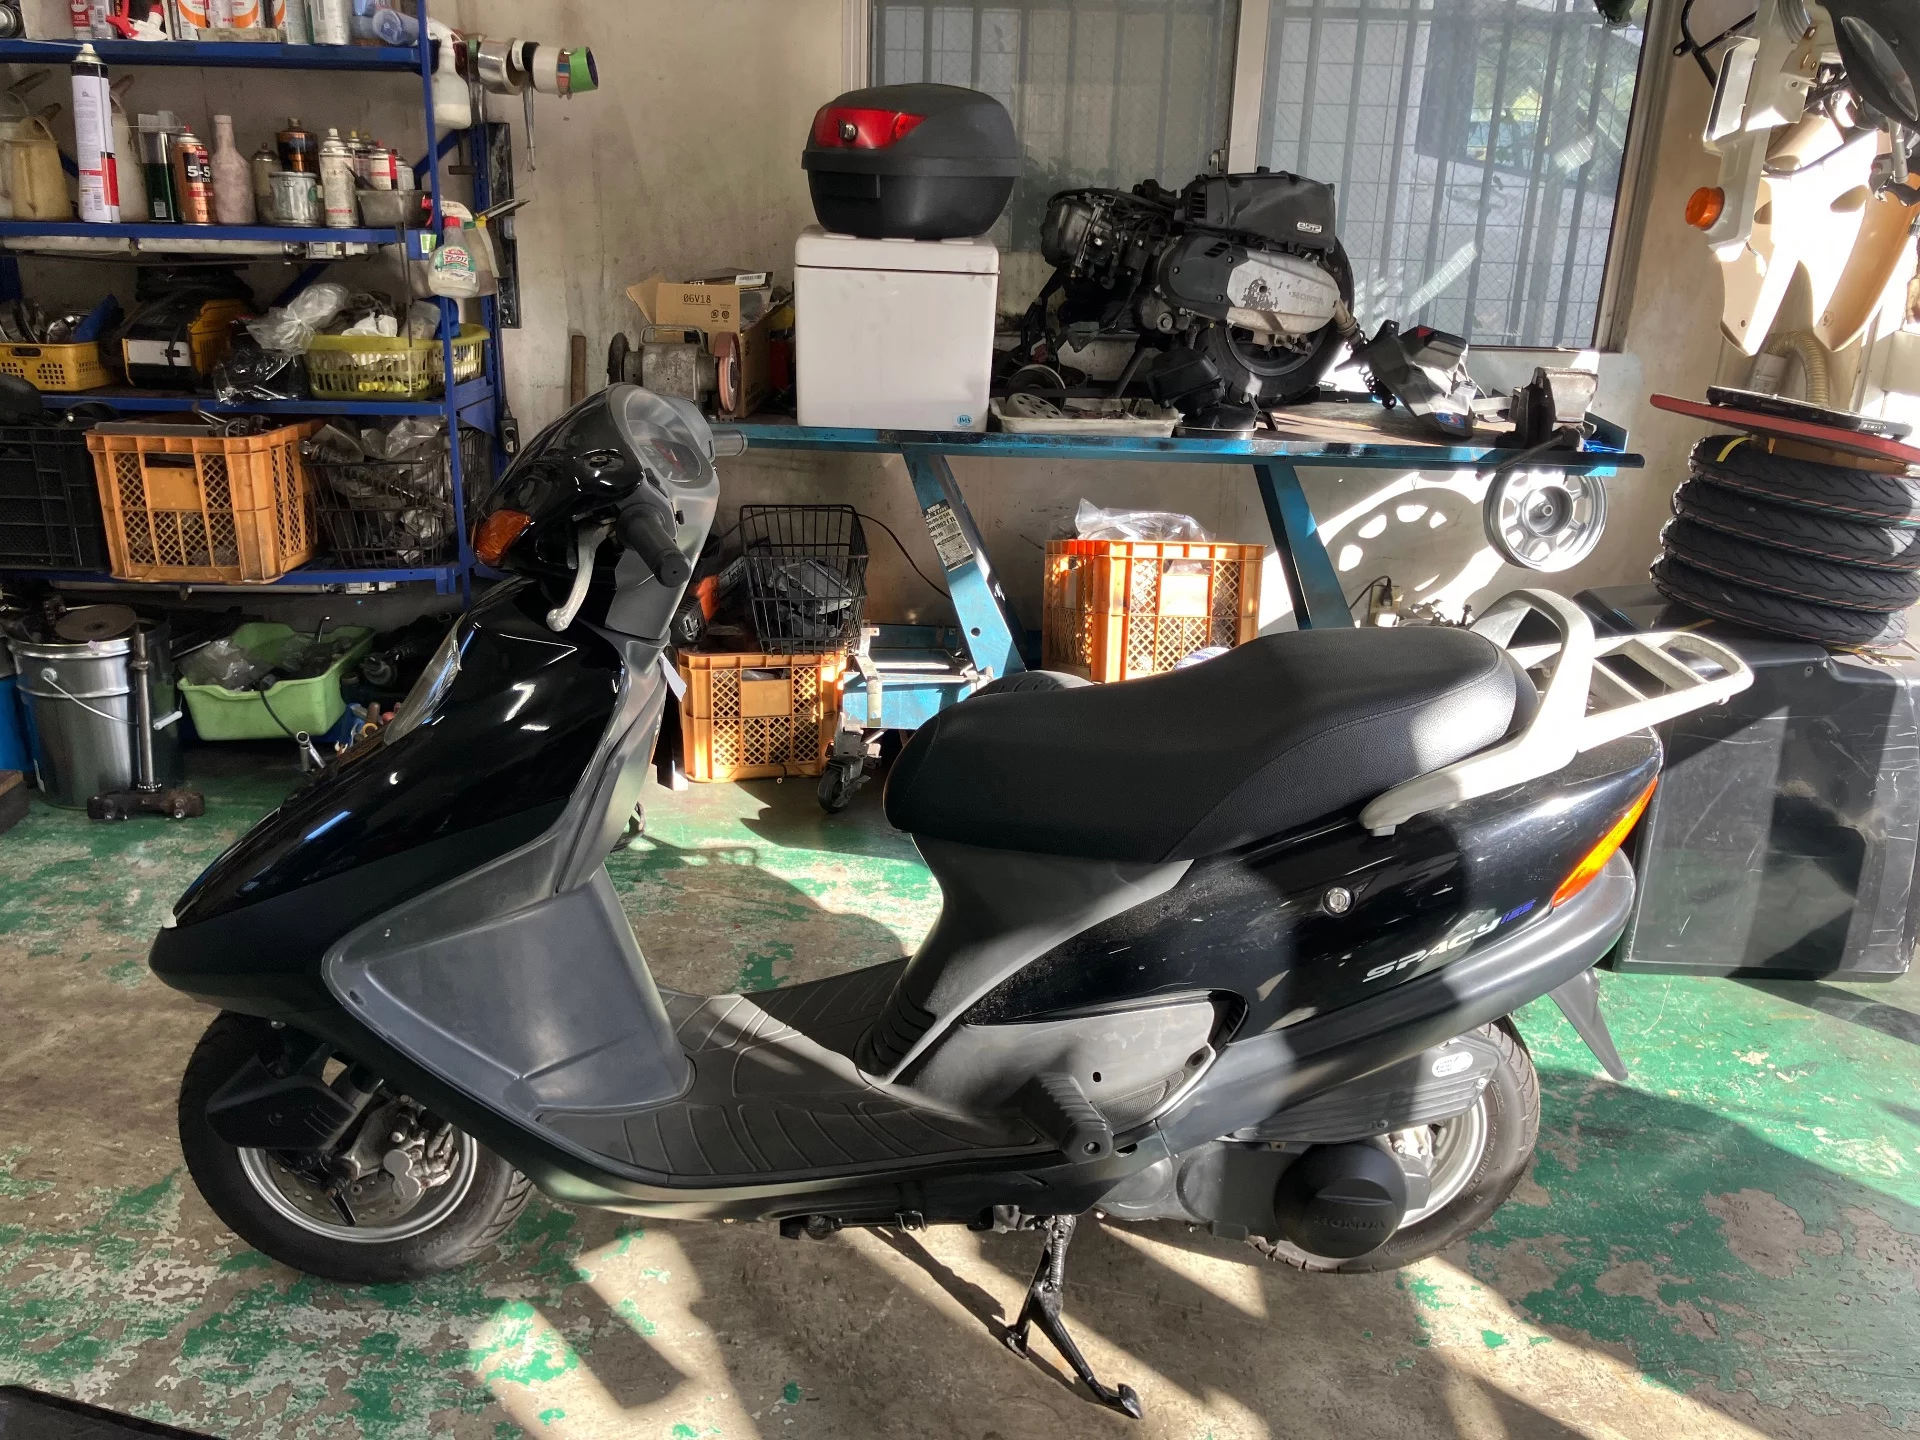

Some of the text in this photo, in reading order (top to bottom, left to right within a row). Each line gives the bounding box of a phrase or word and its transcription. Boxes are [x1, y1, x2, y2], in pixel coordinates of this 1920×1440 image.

[683, 293, 712, 303] 06V18
[1500, 897, 1537, 924] 125
[1313, 1214, 1386, 1230] HONDA
